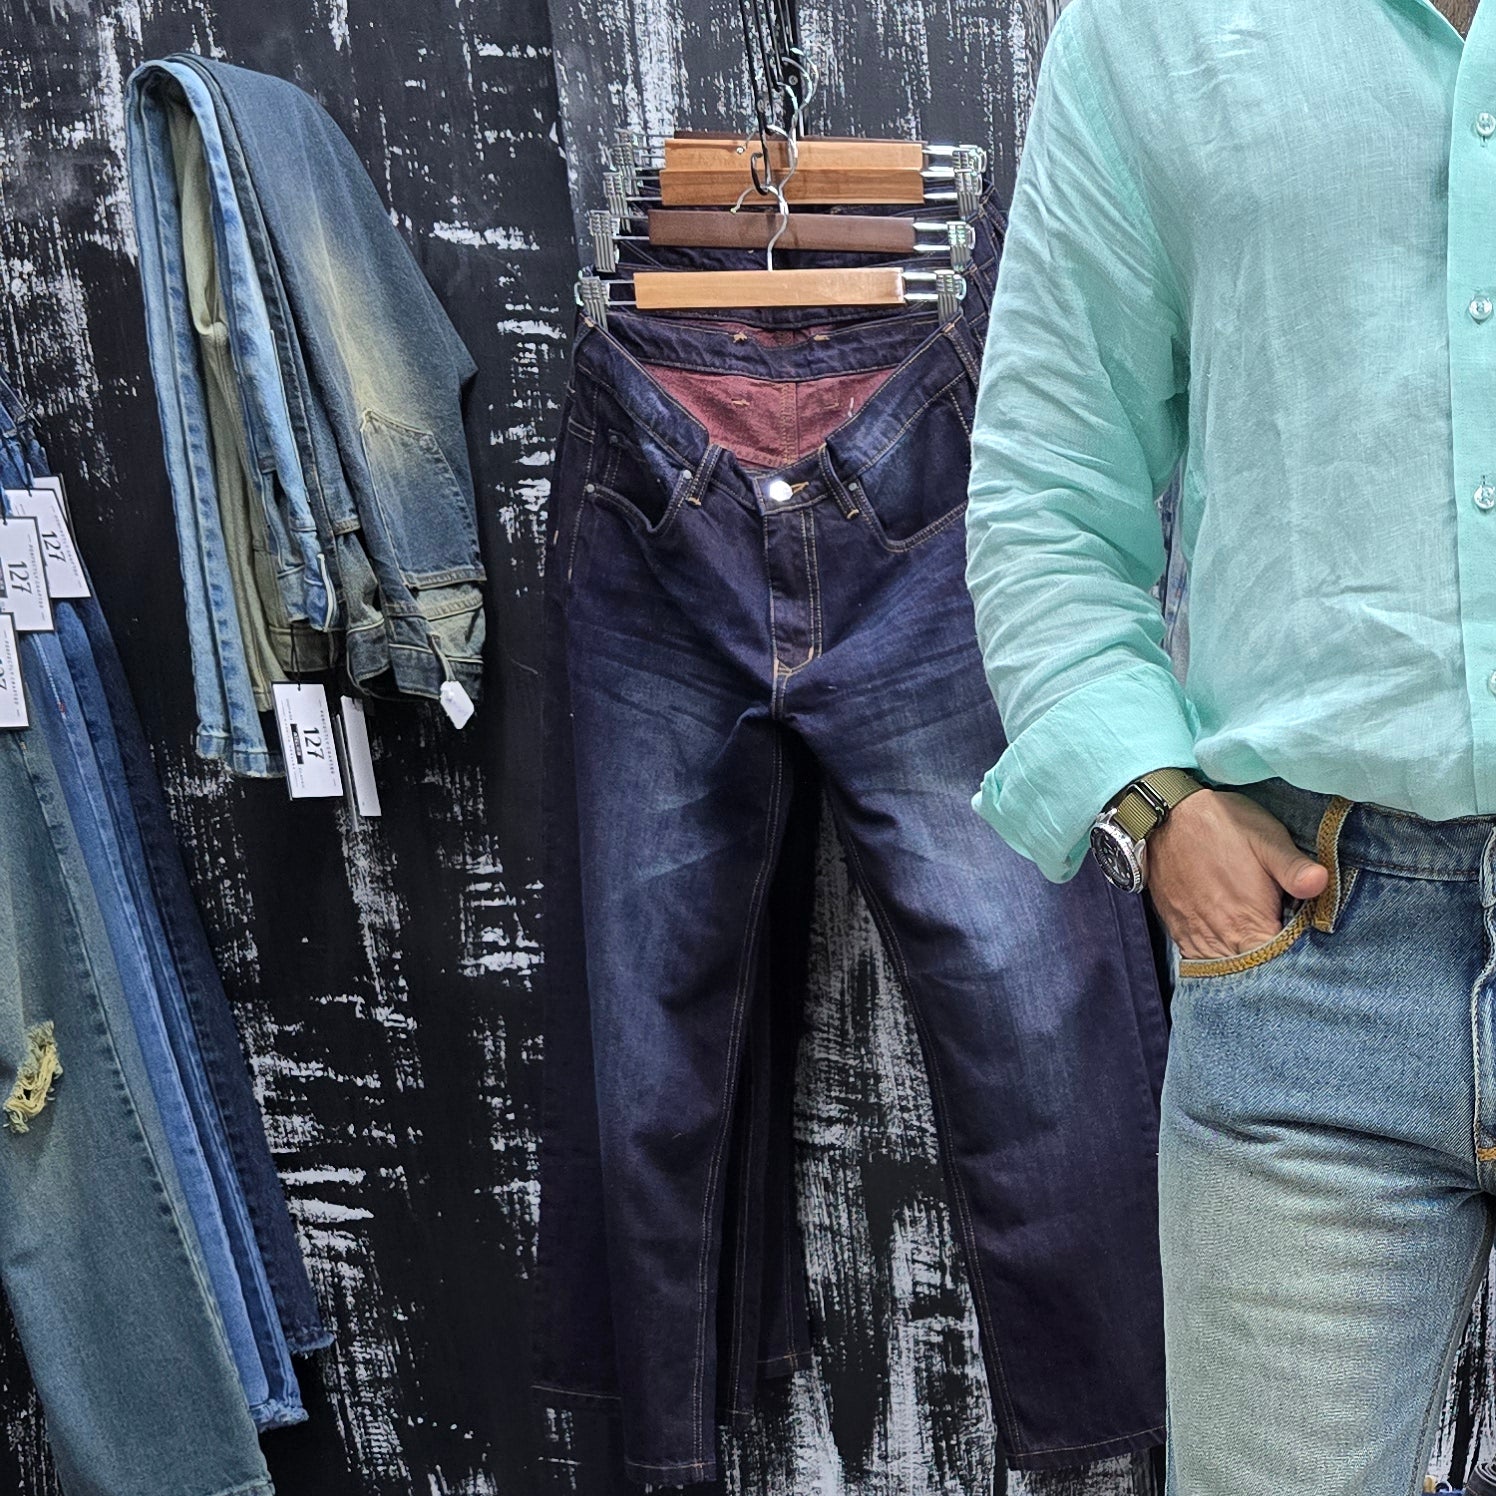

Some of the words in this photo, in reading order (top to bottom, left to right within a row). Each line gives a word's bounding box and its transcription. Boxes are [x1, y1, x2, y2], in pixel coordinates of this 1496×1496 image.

[41, 530, 66, 563] 127
[8, 561, 32, 595] 127
[303, 727, 325, 760] 127
